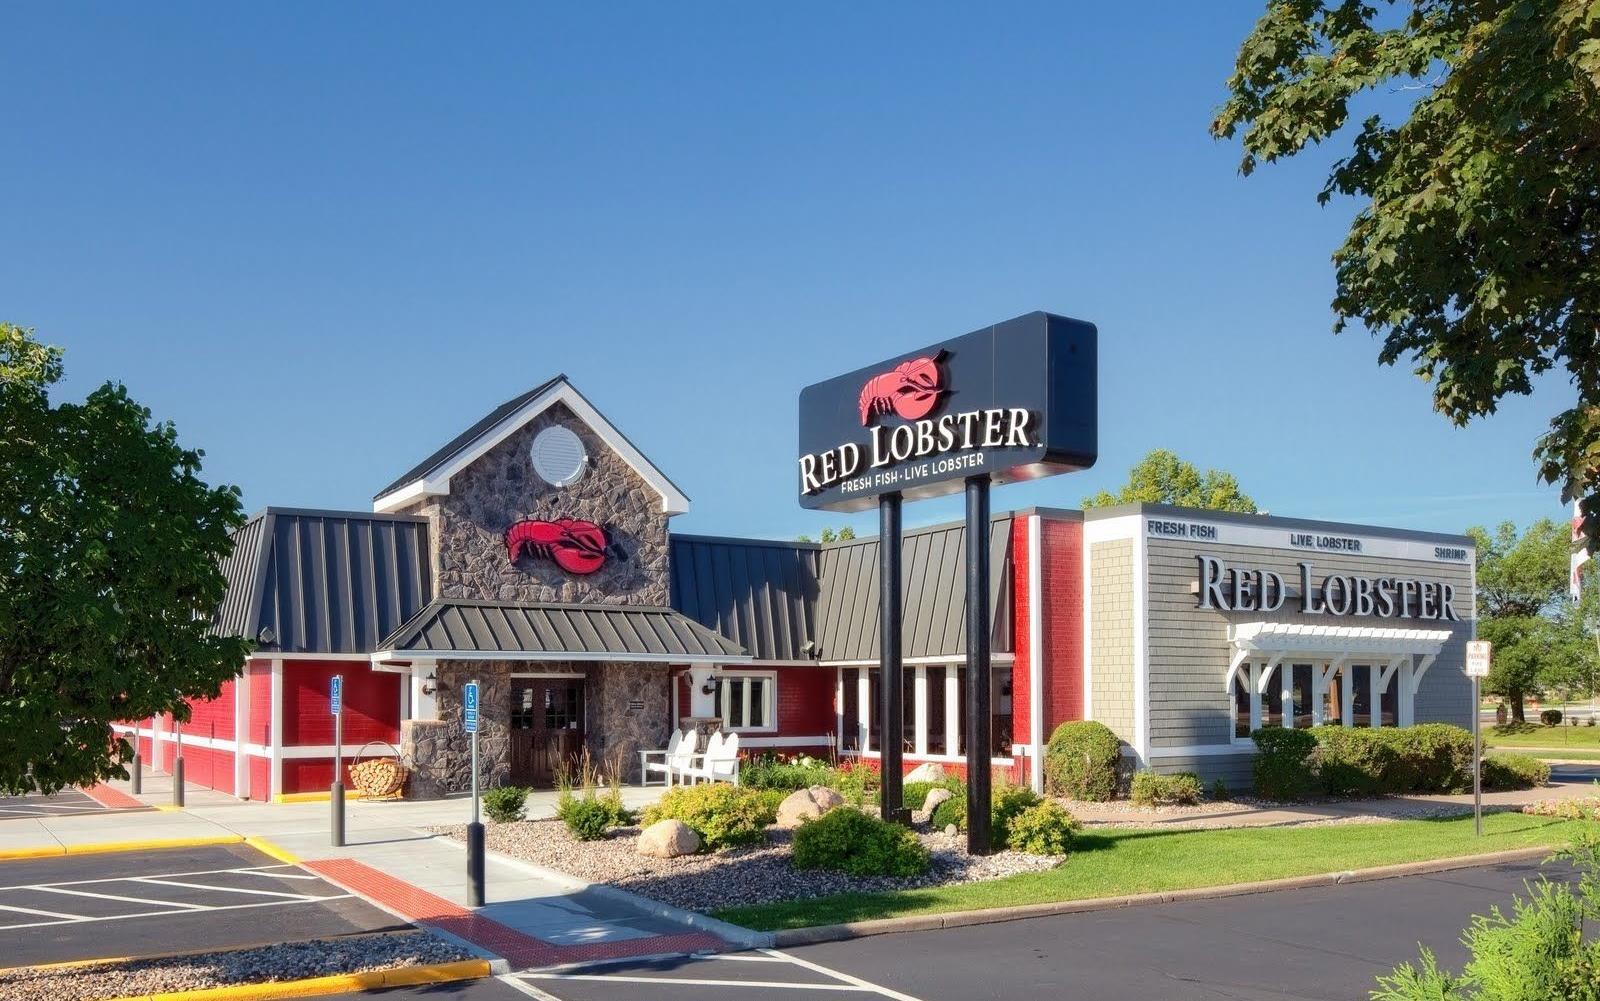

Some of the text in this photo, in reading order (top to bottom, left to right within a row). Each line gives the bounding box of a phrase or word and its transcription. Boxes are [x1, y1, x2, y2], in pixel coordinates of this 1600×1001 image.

[799, 408, 1030, 495] RED LOBSTER
[841, 452, 984, 493] FRESH FISH LIVE LOBSTER
[1147, 520, 1216, 538] FRESH FISH
[1290, 533, 1361, 551] LIVE LOBSTER
[1434, 546, 1466, 561] SHRIMP
[1196, 554, 1460, 622] RED LOBSTER
